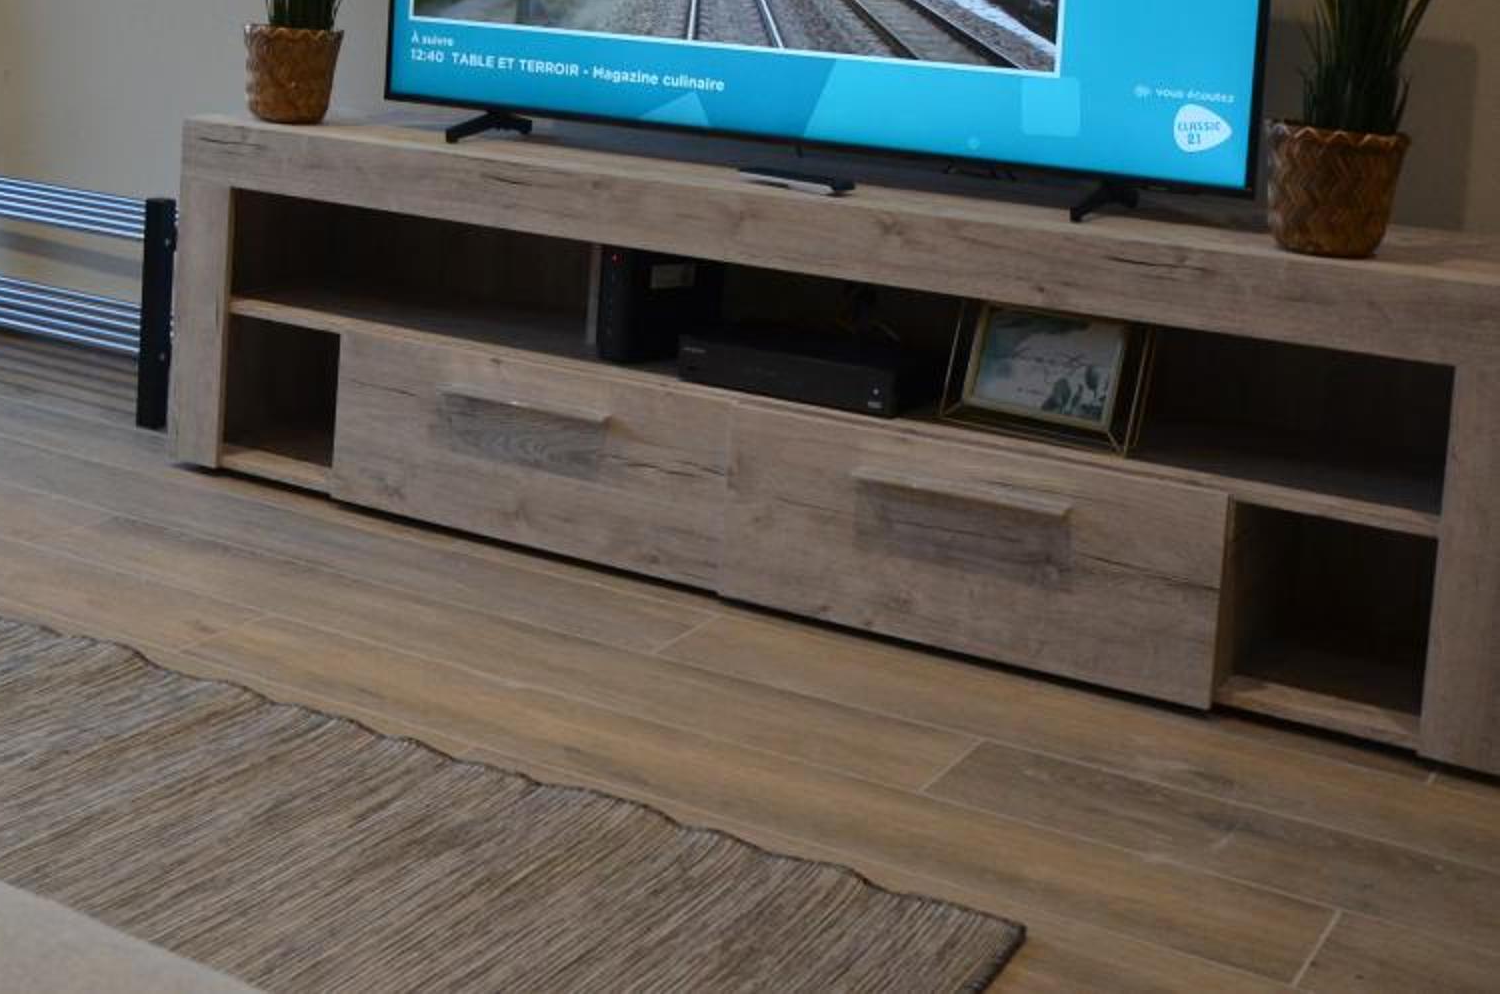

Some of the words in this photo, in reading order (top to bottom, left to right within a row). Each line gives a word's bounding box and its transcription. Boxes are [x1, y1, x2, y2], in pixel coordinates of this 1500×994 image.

[421, 35, 453, 47] suivre
[411, 48, 445, 63] 12:40
[452, 51, 495, 68] TABLE
[497, 57, 516, 69] ET
[519, 59, 579, 77] TERROIR
[592, 66, 659, 85] Magazine
[663, 74, 725, 92] culinaire
